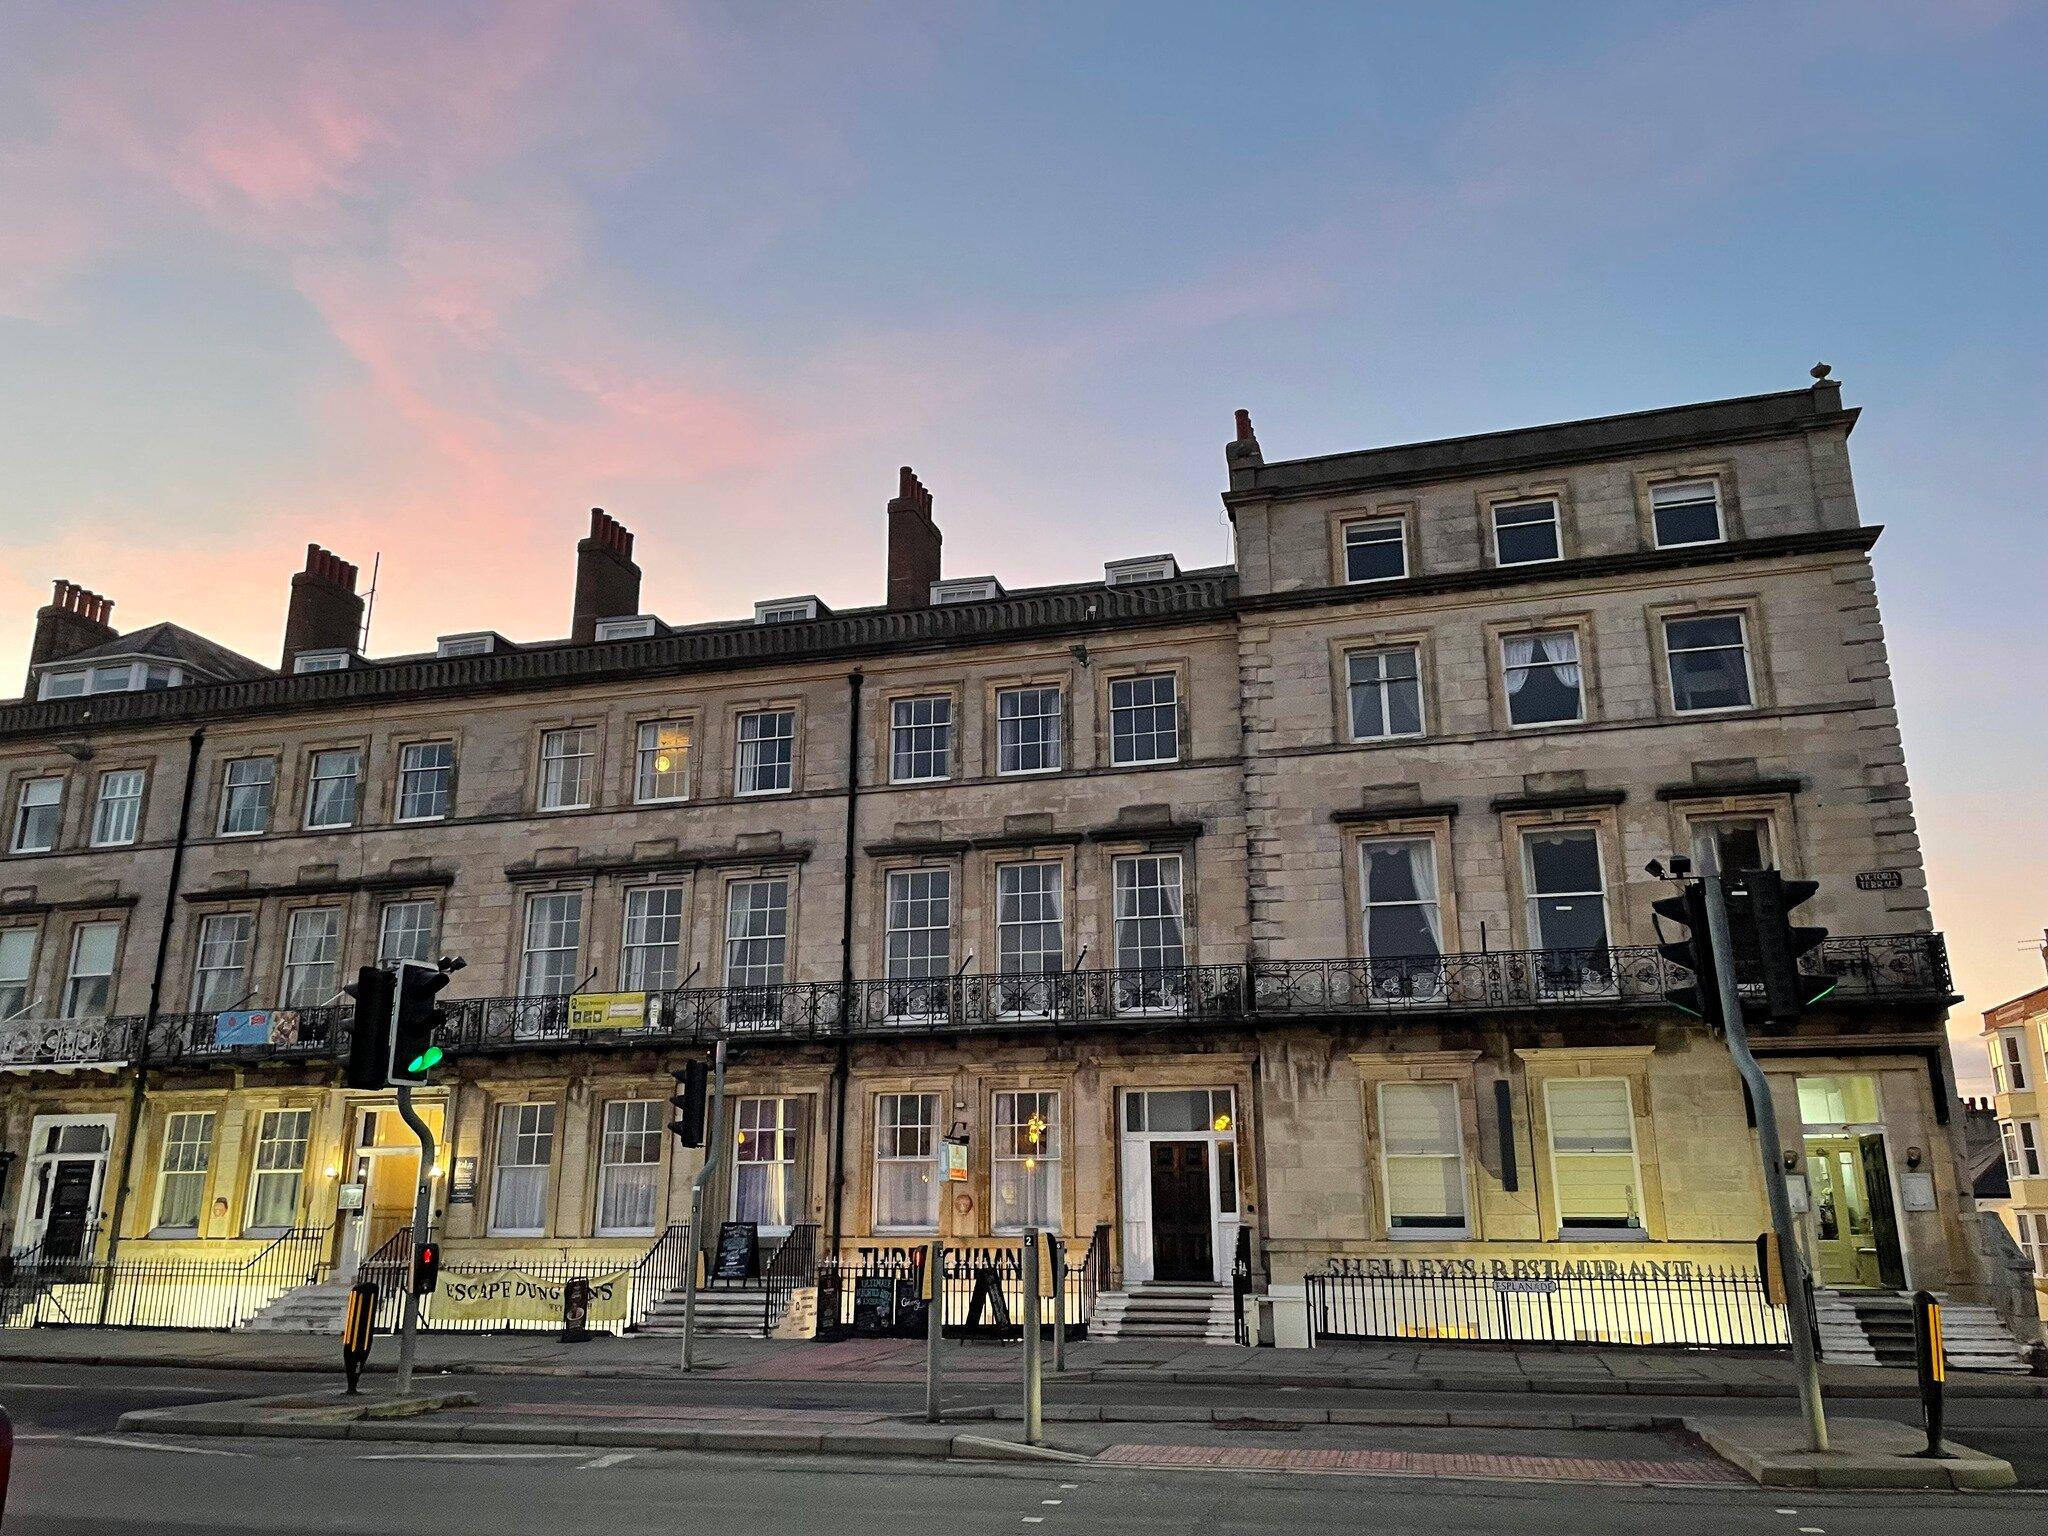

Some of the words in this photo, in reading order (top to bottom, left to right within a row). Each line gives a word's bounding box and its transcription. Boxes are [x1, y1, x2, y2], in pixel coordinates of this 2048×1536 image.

[1858, 872, 1899, 881] VICTORIA
[1025, 1236, 1032, 1246] 2
[1328, 1257, 1476, 1277] SHELLEY'S
[1489, 1258, 1693, 1280] RESTAURANT
[445, 1281, 511, 1301] ESCAPE
[516, 1281, 614, 1301] DUNGNS
[1495, 1281, 1553, 1291] ESPLANADE
